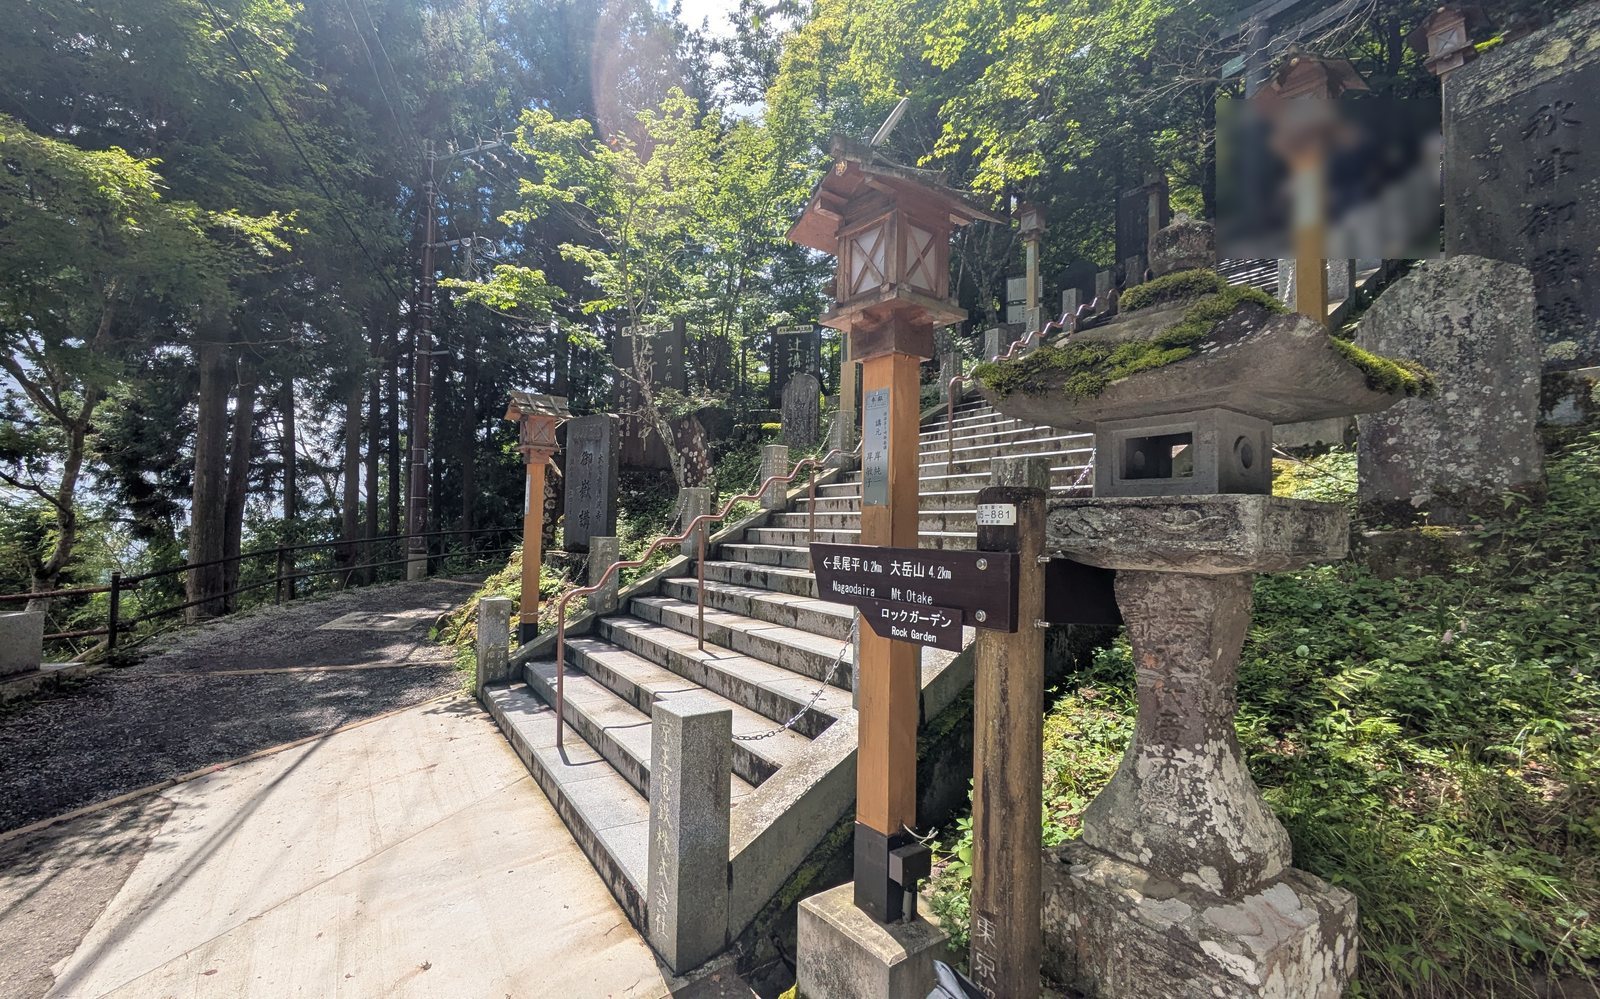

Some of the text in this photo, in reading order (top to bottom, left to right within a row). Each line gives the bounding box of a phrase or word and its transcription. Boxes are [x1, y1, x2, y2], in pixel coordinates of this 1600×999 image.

[832, 556, 952, 580] 長尾平 0.2km 大岳山 4.2km
[832, 580, 876, 597] Nagaodaira
[891, 587, 933, 605] Mt. Otake
[881, 607, 952, 628] ロックガーデン
[891, 625, 937, 643] Rock Garden
